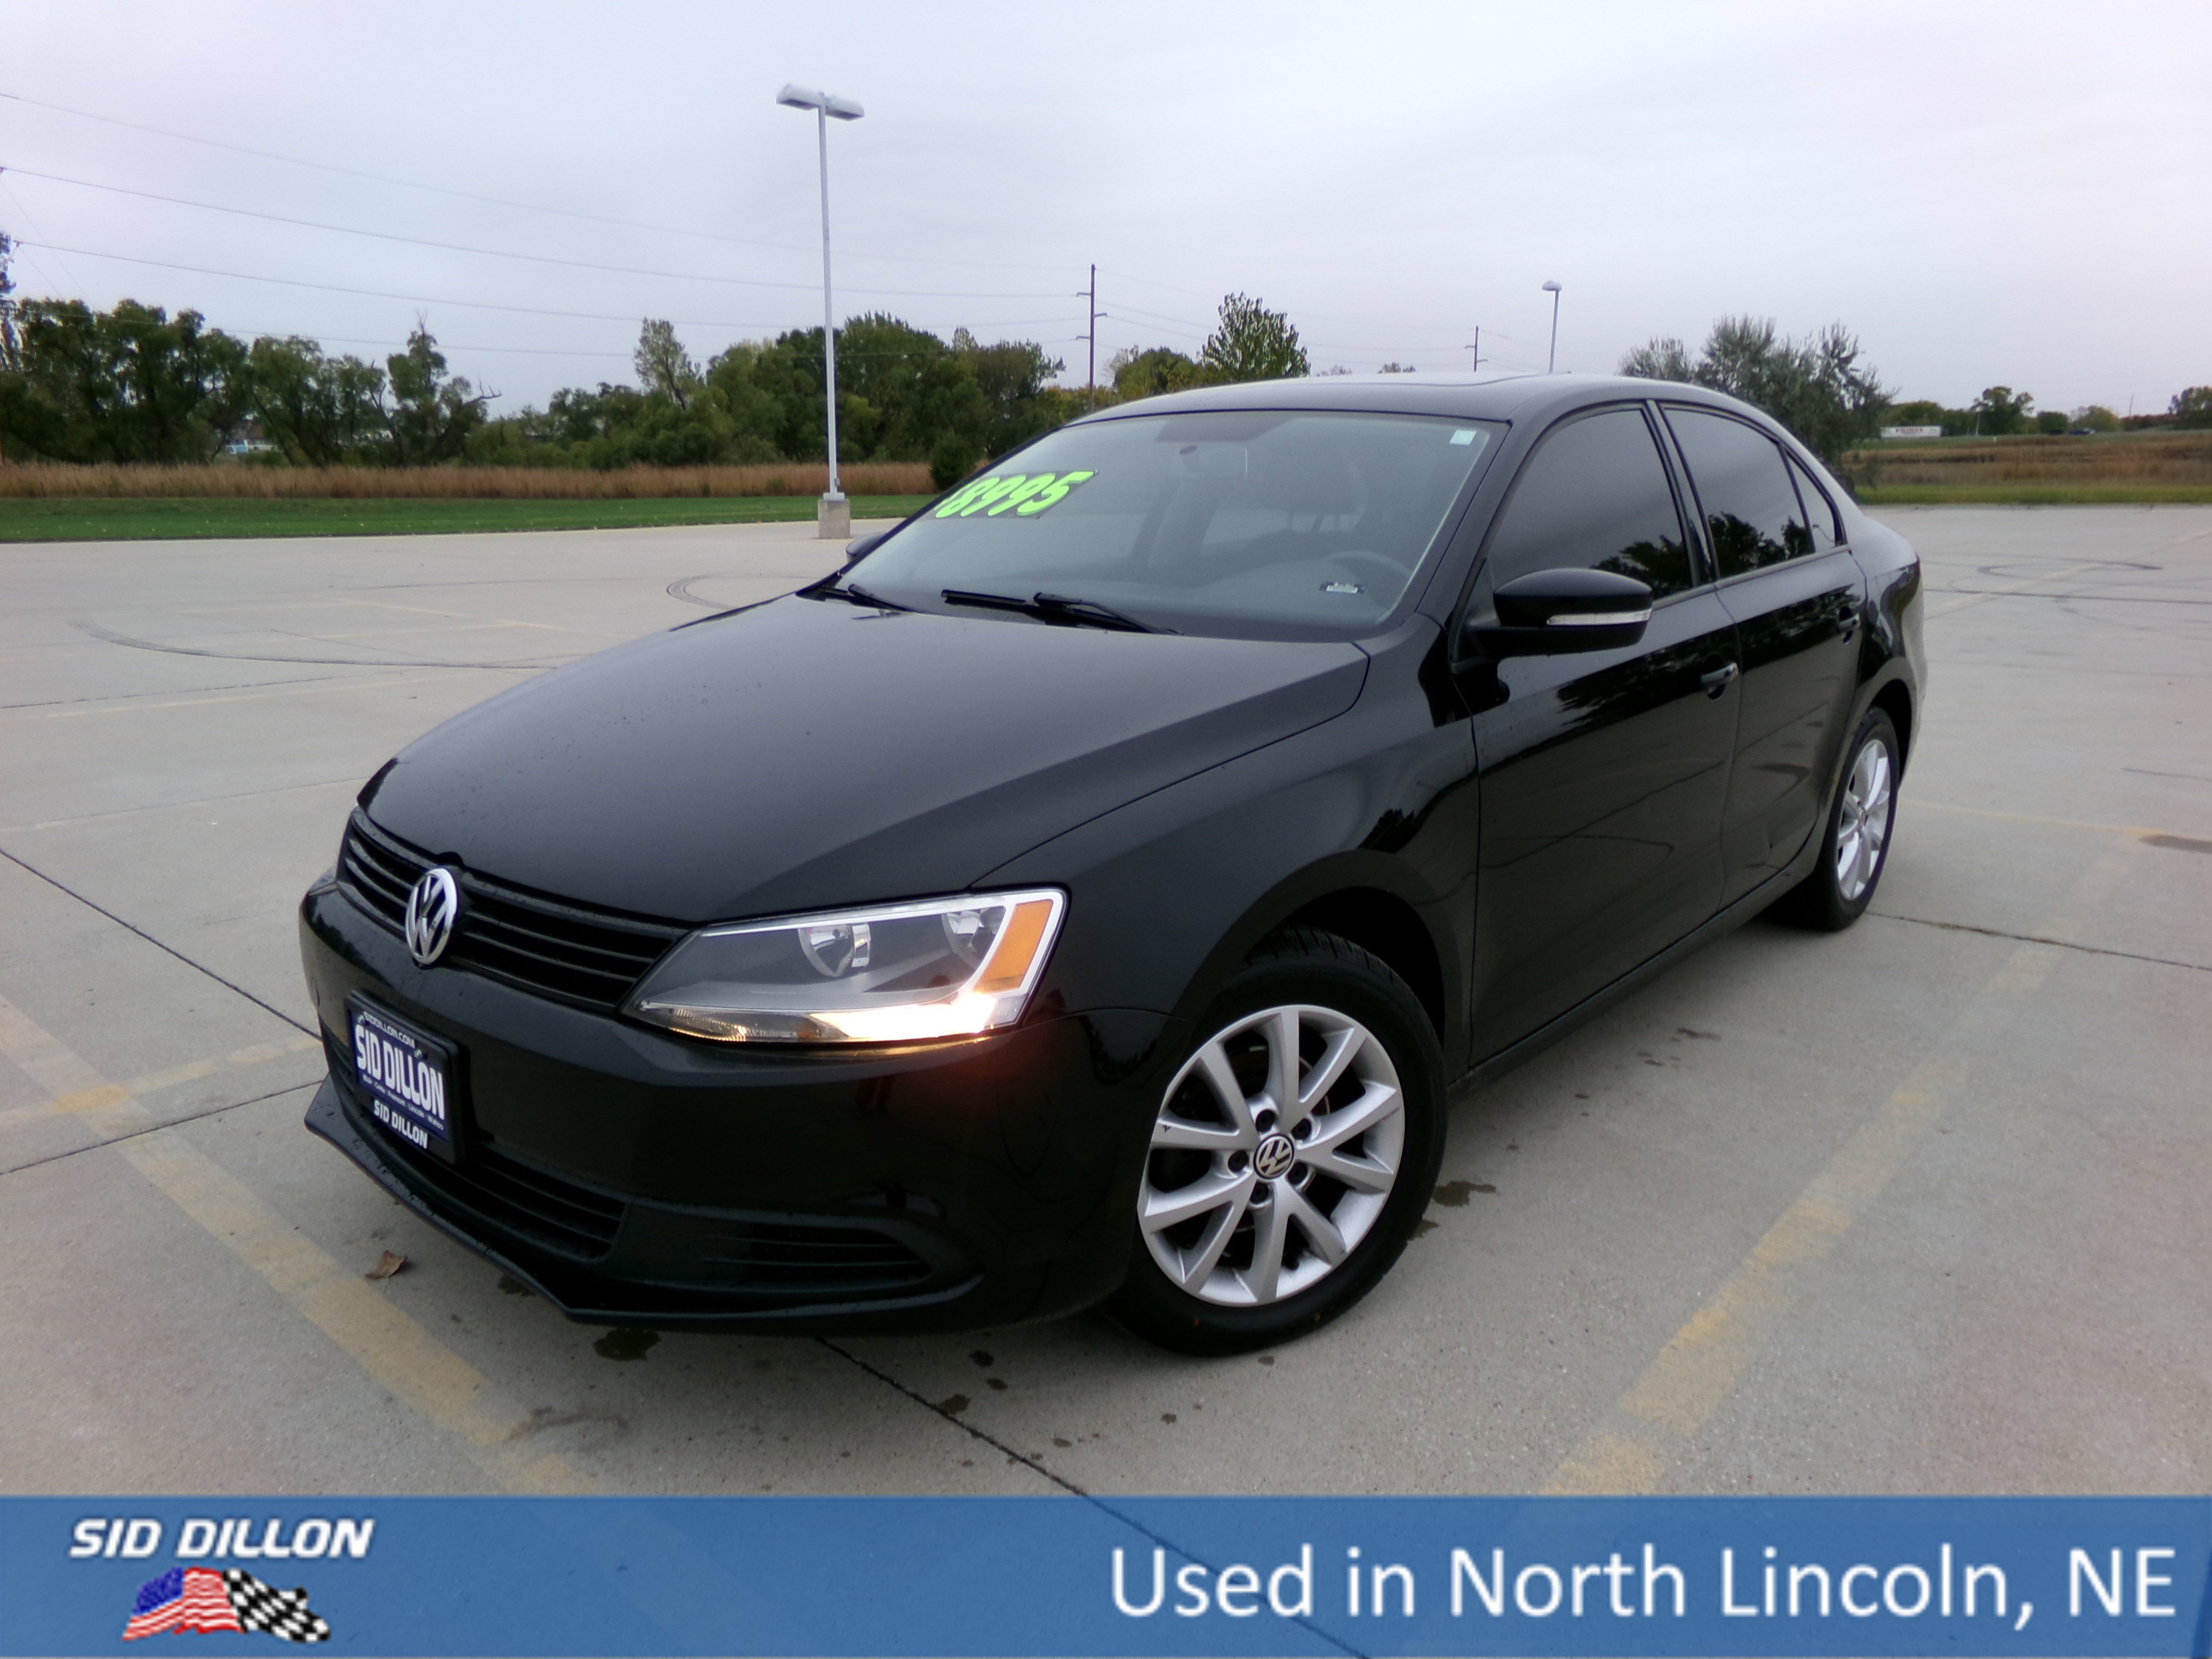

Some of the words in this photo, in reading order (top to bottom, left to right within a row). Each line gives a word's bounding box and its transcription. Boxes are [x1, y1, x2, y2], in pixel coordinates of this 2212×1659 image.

[363, 1011, 415, 1049] SIDDILLON.COM
[355, 1024, 382, 1081] SID
[383, 1040, 445, 1120] DILLON
[374, 1099, 390, 1123] SID
[391, 1111, 428, 1150] DILLON
